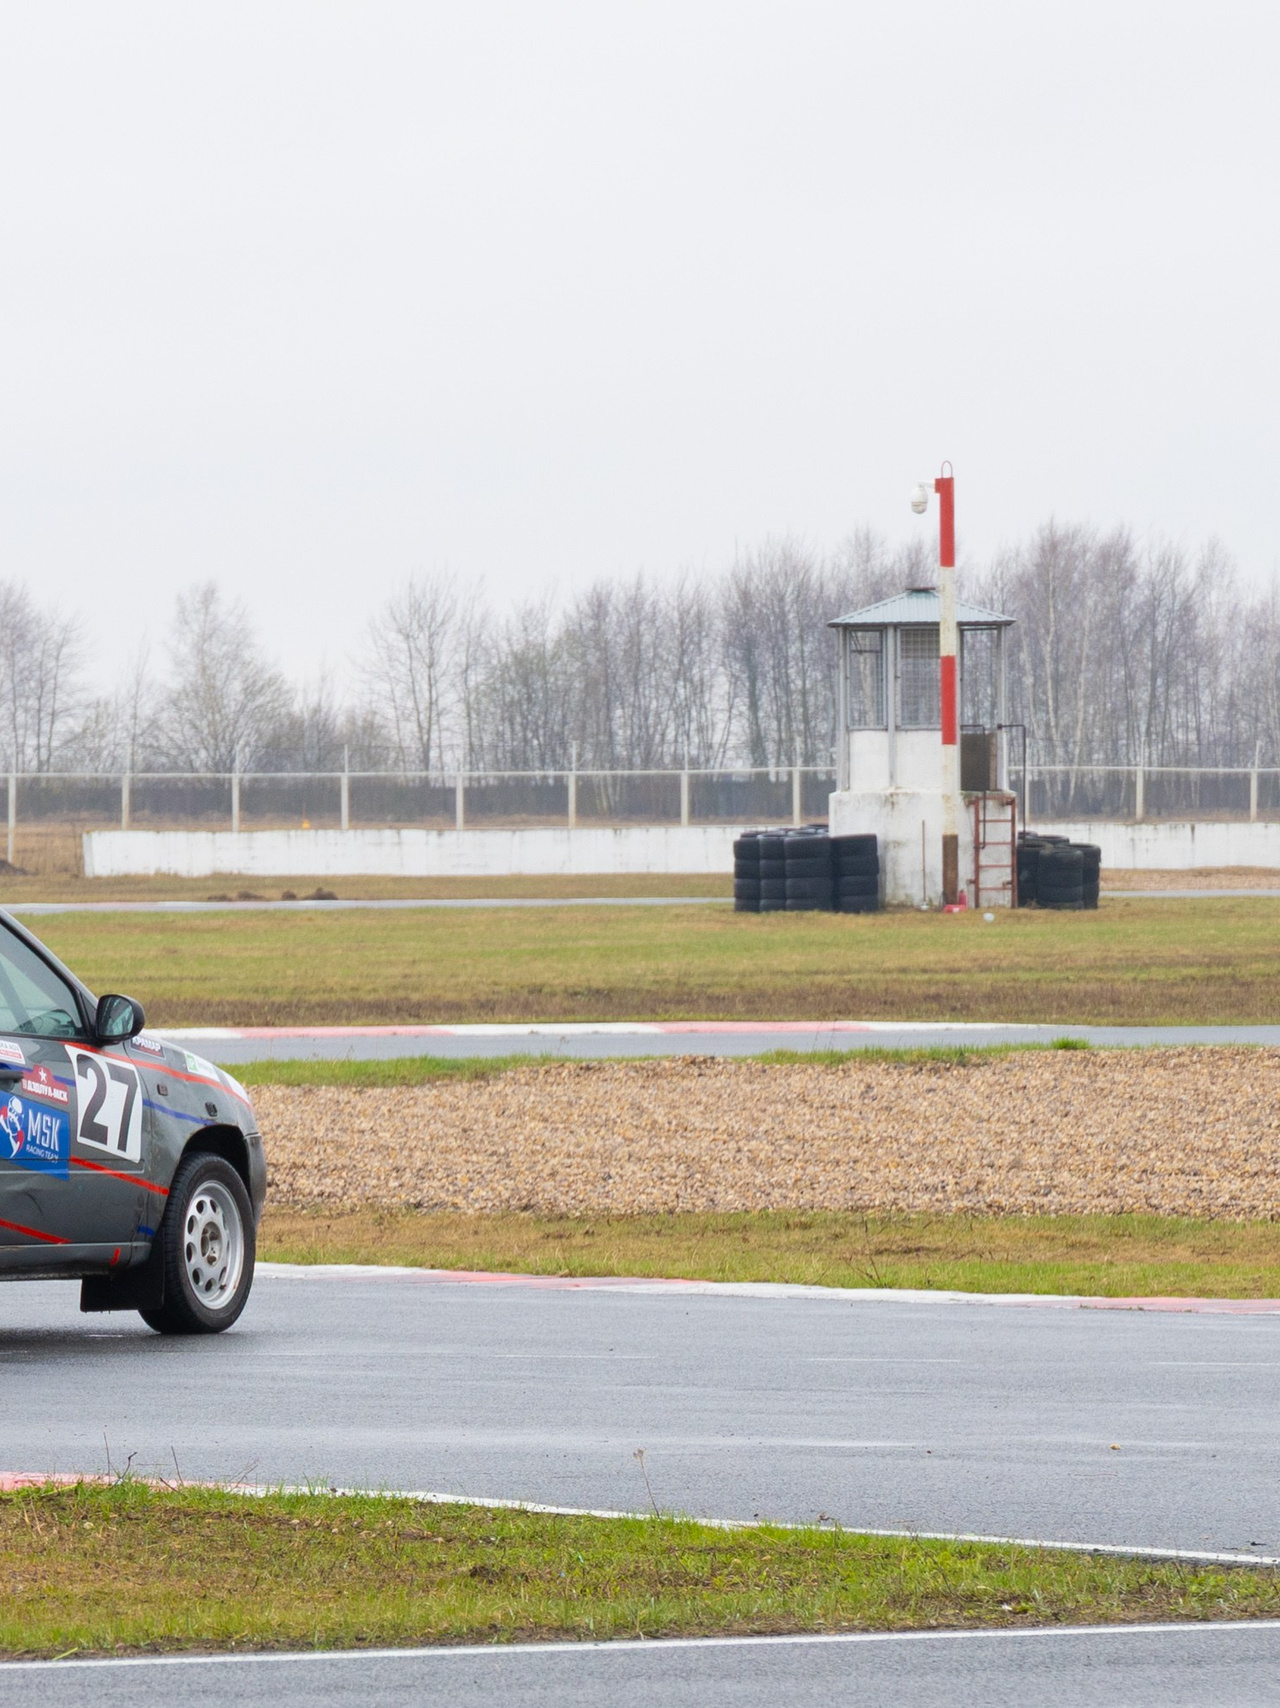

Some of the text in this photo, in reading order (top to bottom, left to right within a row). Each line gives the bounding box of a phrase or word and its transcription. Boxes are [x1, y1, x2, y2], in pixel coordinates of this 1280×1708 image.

[76, 1053, 139, 1153] 27
[25, 1144, 46, 1158] RACING
[27, 1108, 61, 1152] MSK
